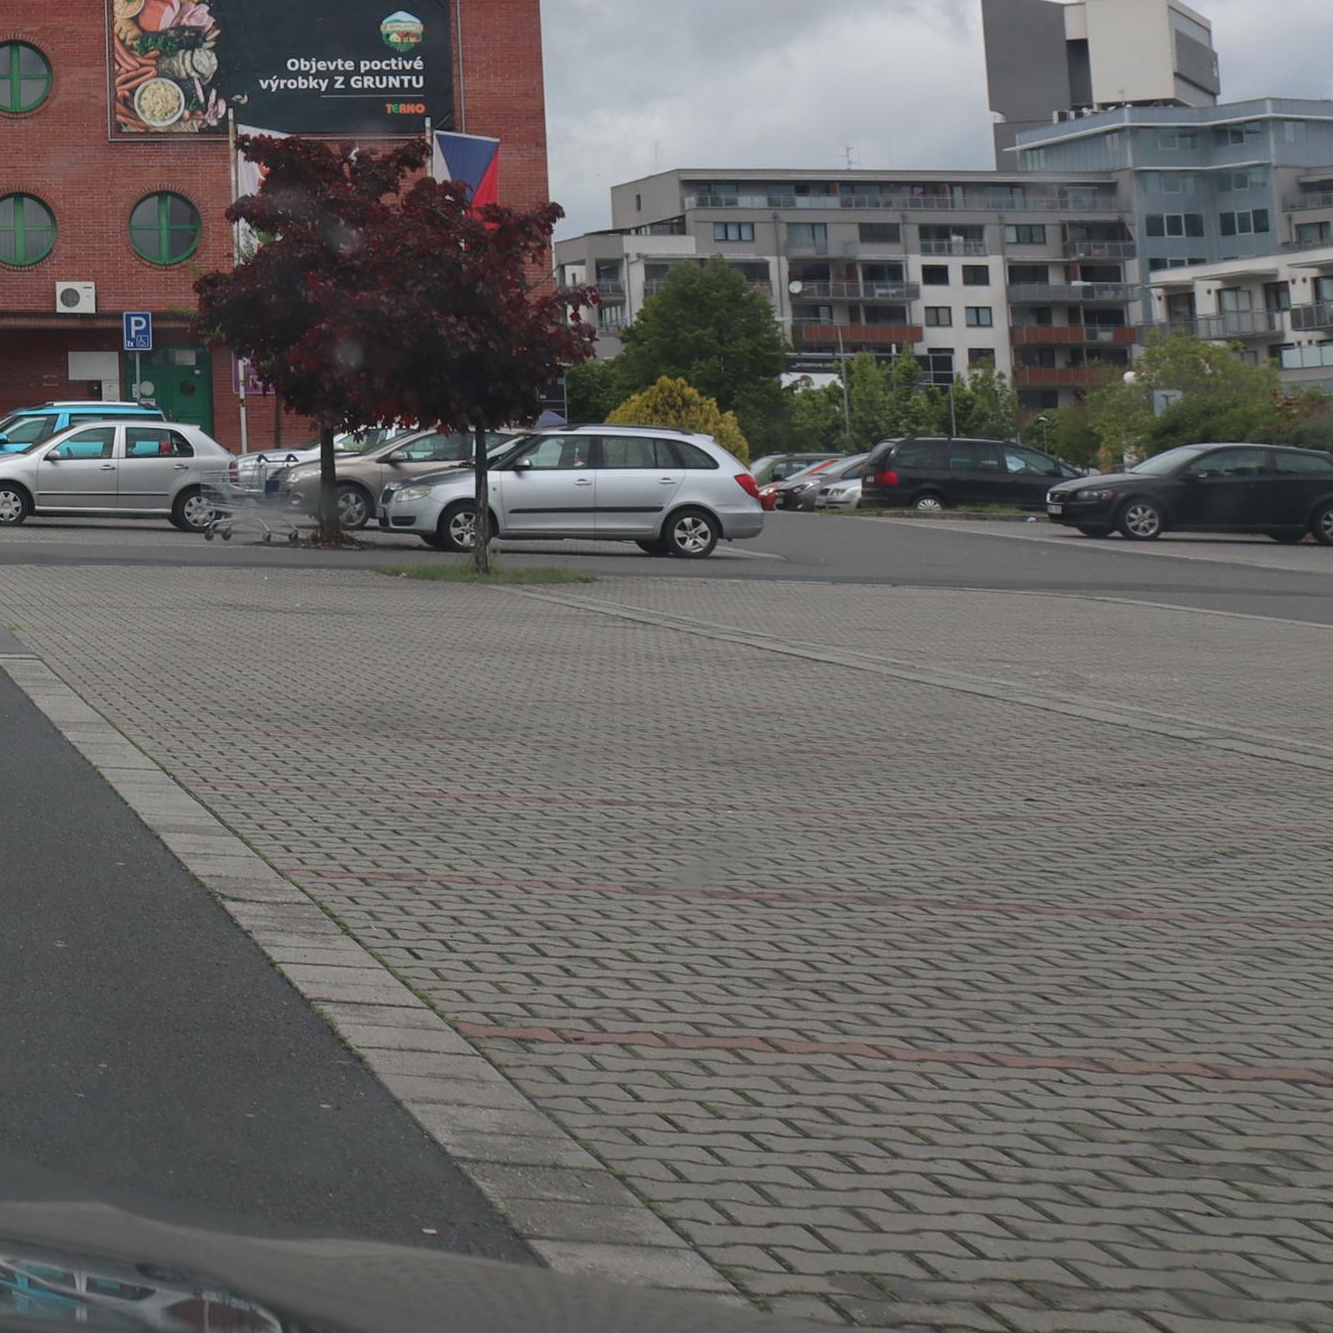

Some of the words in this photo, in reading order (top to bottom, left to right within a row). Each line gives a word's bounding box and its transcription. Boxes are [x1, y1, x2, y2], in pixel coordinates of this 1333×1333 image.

[286, 57, 355, 74] Objevte
[360, 55, 424, 74] poctivé
[259, 75, 329, 92] výrobky
[334, 76, 345, 89] Z
[350, 75, 424, 89] GRUNTU
[385, 103, 425, 114] TERNO
[130, 316, 146, 338] P
